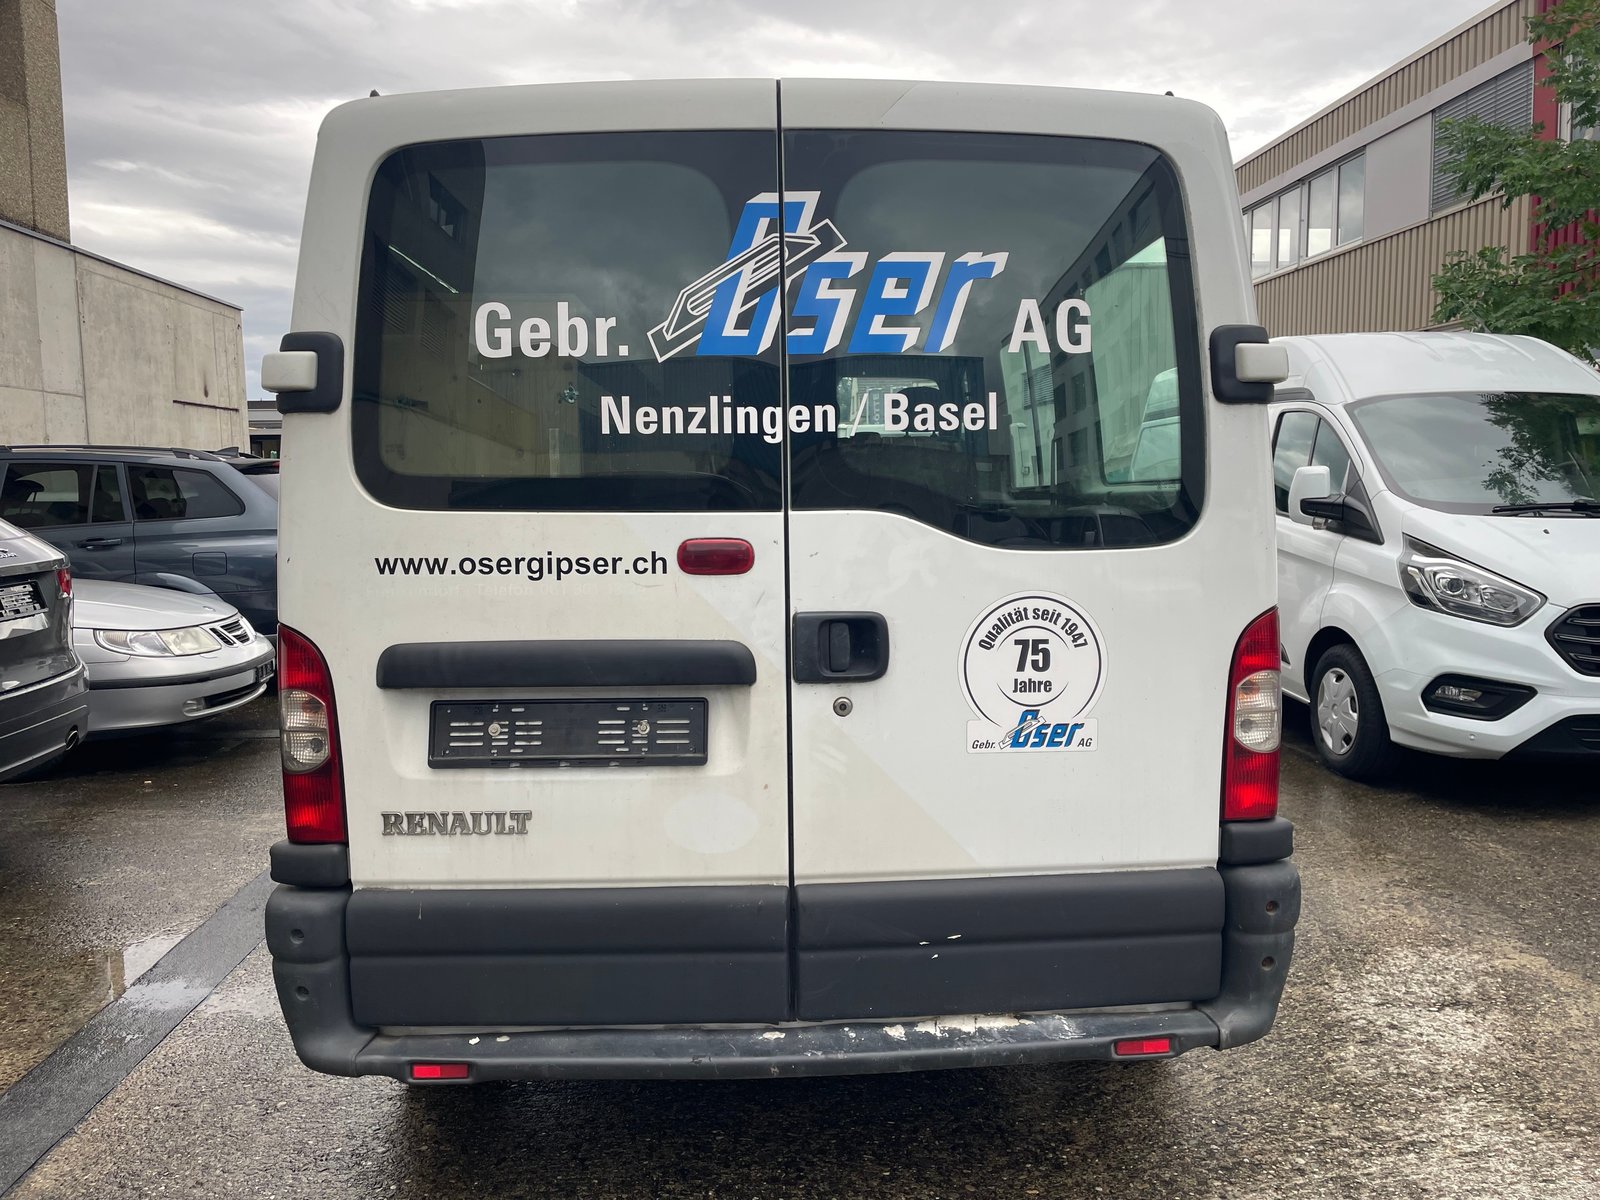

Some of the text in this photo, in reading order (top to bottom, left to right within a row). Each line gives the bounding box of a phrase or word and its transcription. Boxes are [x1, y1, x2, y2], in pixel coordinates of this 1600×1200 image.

[474, 302, 629, 358] Gebr.
[1008, 298, 1092, 354] AG
[600, 396, 837, 443] Nenzlingen
[884, 392, 998, 431] Basel
[375, 551, 668, 580] www.osergipser.ch
[978, 607, 1089, 651] Qualität seit 1947
[1014, 639, 1051, 672] 75
[1012, 678, 1052, 693] Jahre
[972, 739, 996, 750] Gebr.
[1077, 737, 1093, 748] AG
[381, 810, 533, 836] RENAULT
